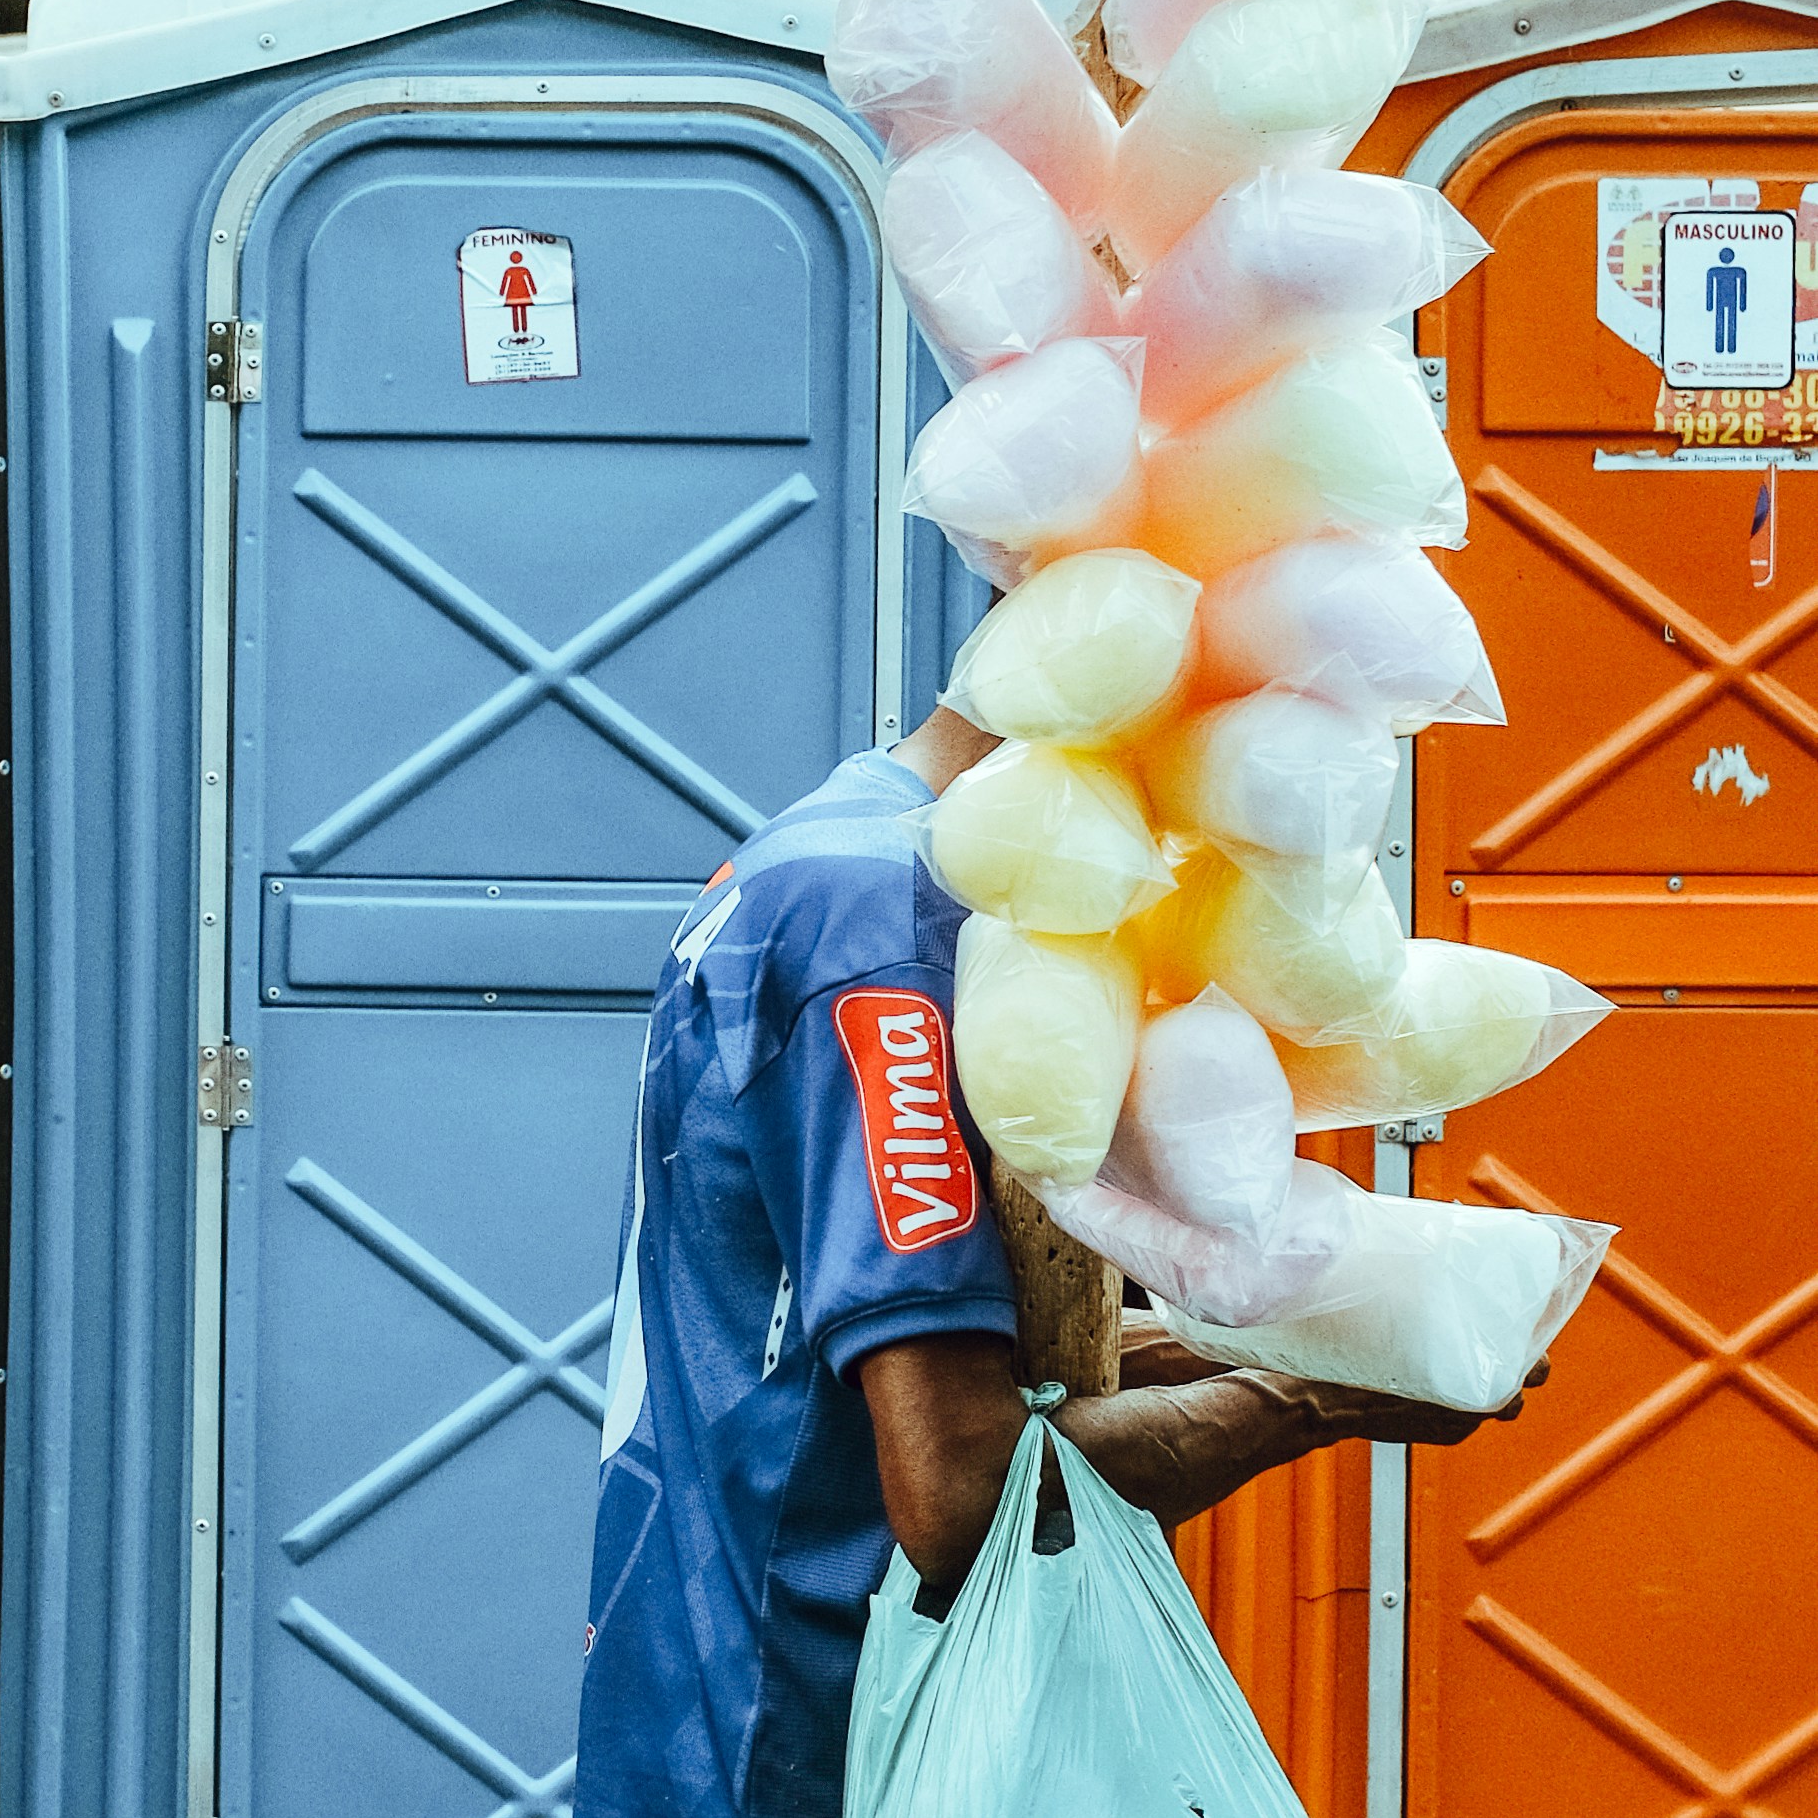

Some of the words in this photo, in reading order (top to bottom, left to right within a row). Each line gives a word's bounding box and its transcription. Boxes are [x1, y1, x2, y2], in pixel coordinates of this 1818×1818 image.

[1674, 224, 1783, 240] MASCULINO
[472, 233, 557, 249] FEMININO
[877, 1010, 960, 1237] Vilma
